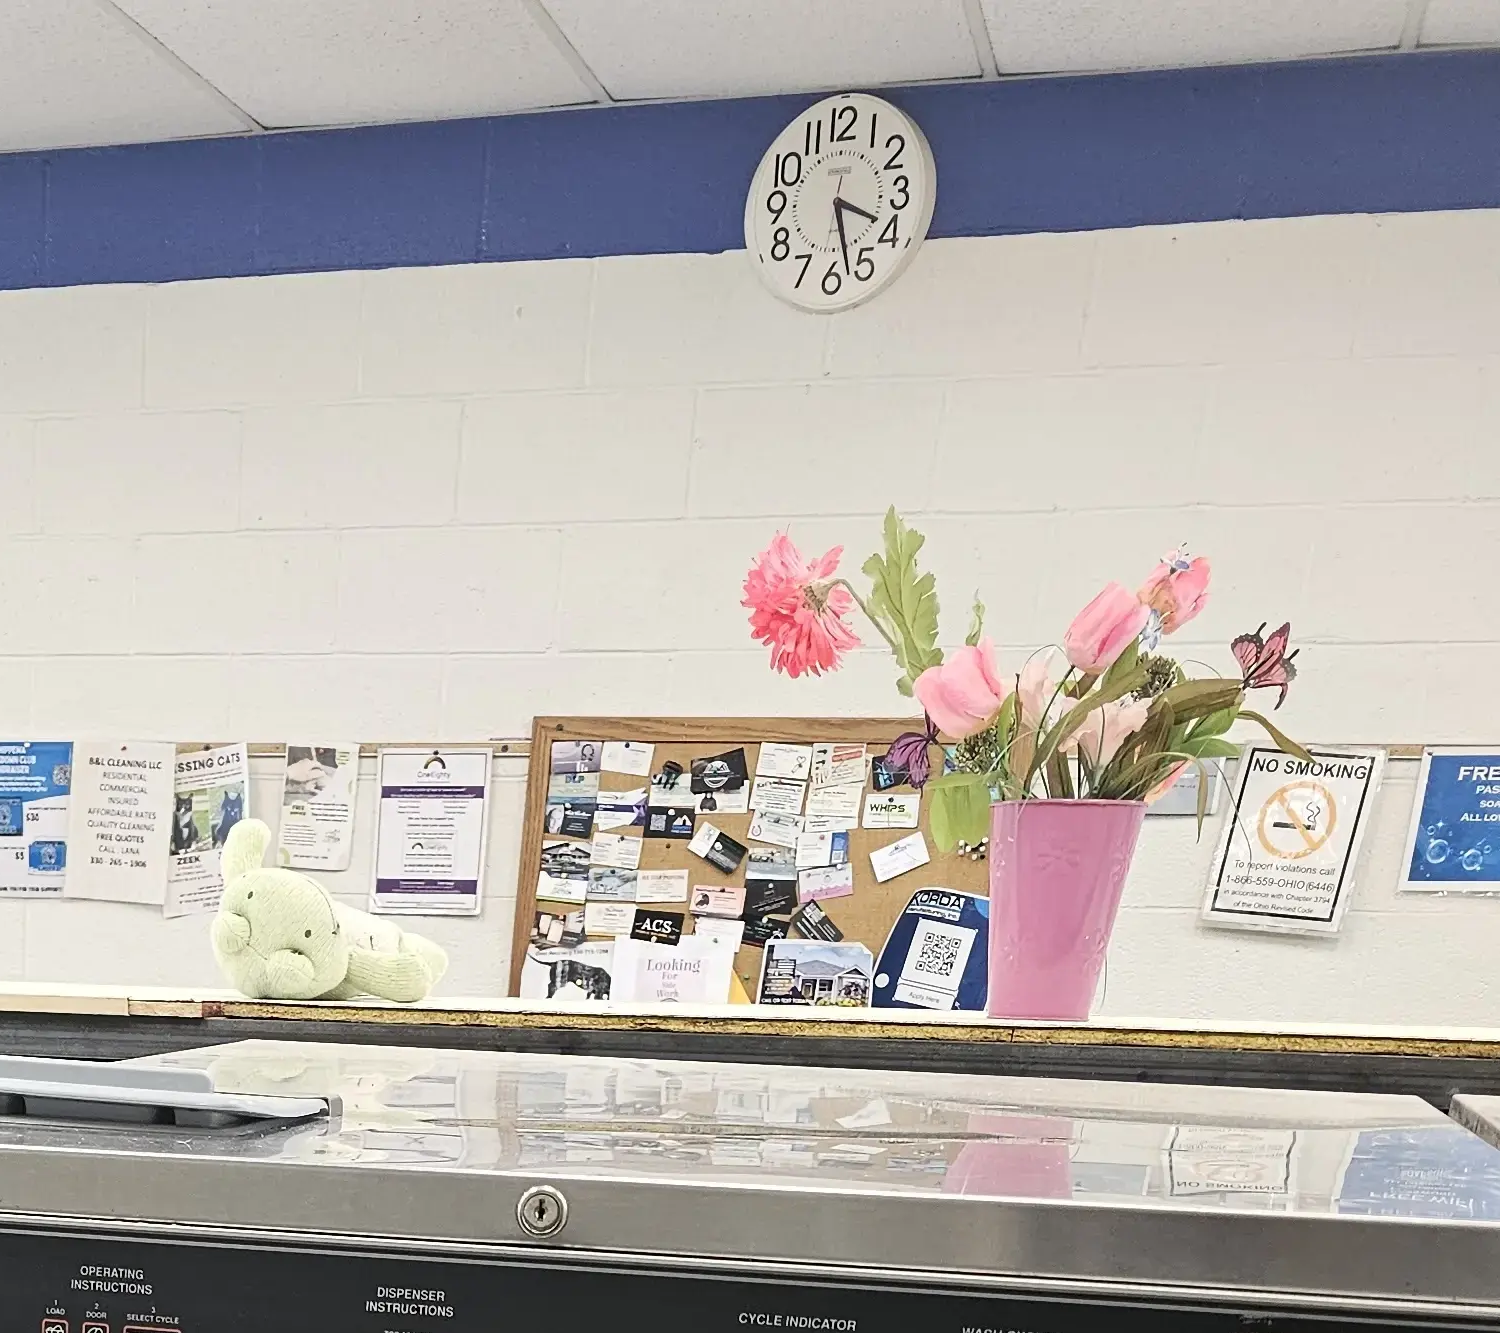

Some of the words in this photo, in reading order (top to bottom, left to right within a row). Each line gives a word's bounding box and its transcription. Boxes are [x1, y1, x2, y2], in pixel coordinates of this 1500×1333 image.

[830, 106, 858, 142] 12
[870, 113, 878, 148] 1
[805, 120, 822, 156] 11
[883, 134, 905, 170] 2
[774, 152, 802, 188] 10
[890, 175, 910, 210] 3
[767, 190, 787, 225] 9
[877, 214, 899, 249] 4
[770, 227, 790, 261] 8
[794, 254, 812, 289] 7
[854, 247, 875, 282] 5
[821, 260, 841, 295] 6
[89, 757, 105, 766] B&L
[107, 758, 147, 769] CLEANING
[149, 761, 162, 770] LLC
[174, 758, 214, 774] SSING
[217, 752, 240, 766] CATS
[1253, 758, 1279, 772] NO
[1284, 760, 1368, 780] SMOKING
[103, 772, 147, 782] RESIDENTIAL
[100, 784, 148, 794] COMMERCIAL
[108, 797, 139, 806] INSURED
[869, 804, 906, 813] WHIPS
[88, 808, 132, 818] AFFORDABLE
[135, 812, 156, 820] RATES
[1460, 812, 1482, 821] ALL
[1484, 813, 1500, 821] LO
[87, 820, 117, 828] QUALITY
[119, 822, 155, 832] CLEANING
[96, 833, 112, 841] FREE
[115, 834, 144, 843] QUOTES
[1235, 860, 1244, 868] To
[1247, 862, 1273, 870] report
[1276, 864, 1316, 874] violations
[1320, 868, 1335, 876] call
[1286, 894, 1312, 902] Chapter
[1271, 904, 1296, 912] Revised
[641, 917, 673, 934] ACS
[646, 958, 701, 973] Looking
[662, 972, 678, 980] For
[908, 991, 924, 1000] Apply
[926, 994, 940, 1004] Here
[80, 1266, 144, 1280] OPERATING
[70, 1279, 153, 1295] INSTRUCTIONS
[377, 1286, 445, 1302] DISPENSER
[46, 1307, 65, 1316] LOAD
[86, 1311, 107, 1319] DOOR
[366, 1301, 454, 1318] INSTRUCTIONS
[126, 1313, 155, 1323] SELECT
[156, 1316, 180, 1325] CYCLE
[738, 1312, 782, 1326] CYCLE
[785, 1316, 857, 1331] INDICATOR
